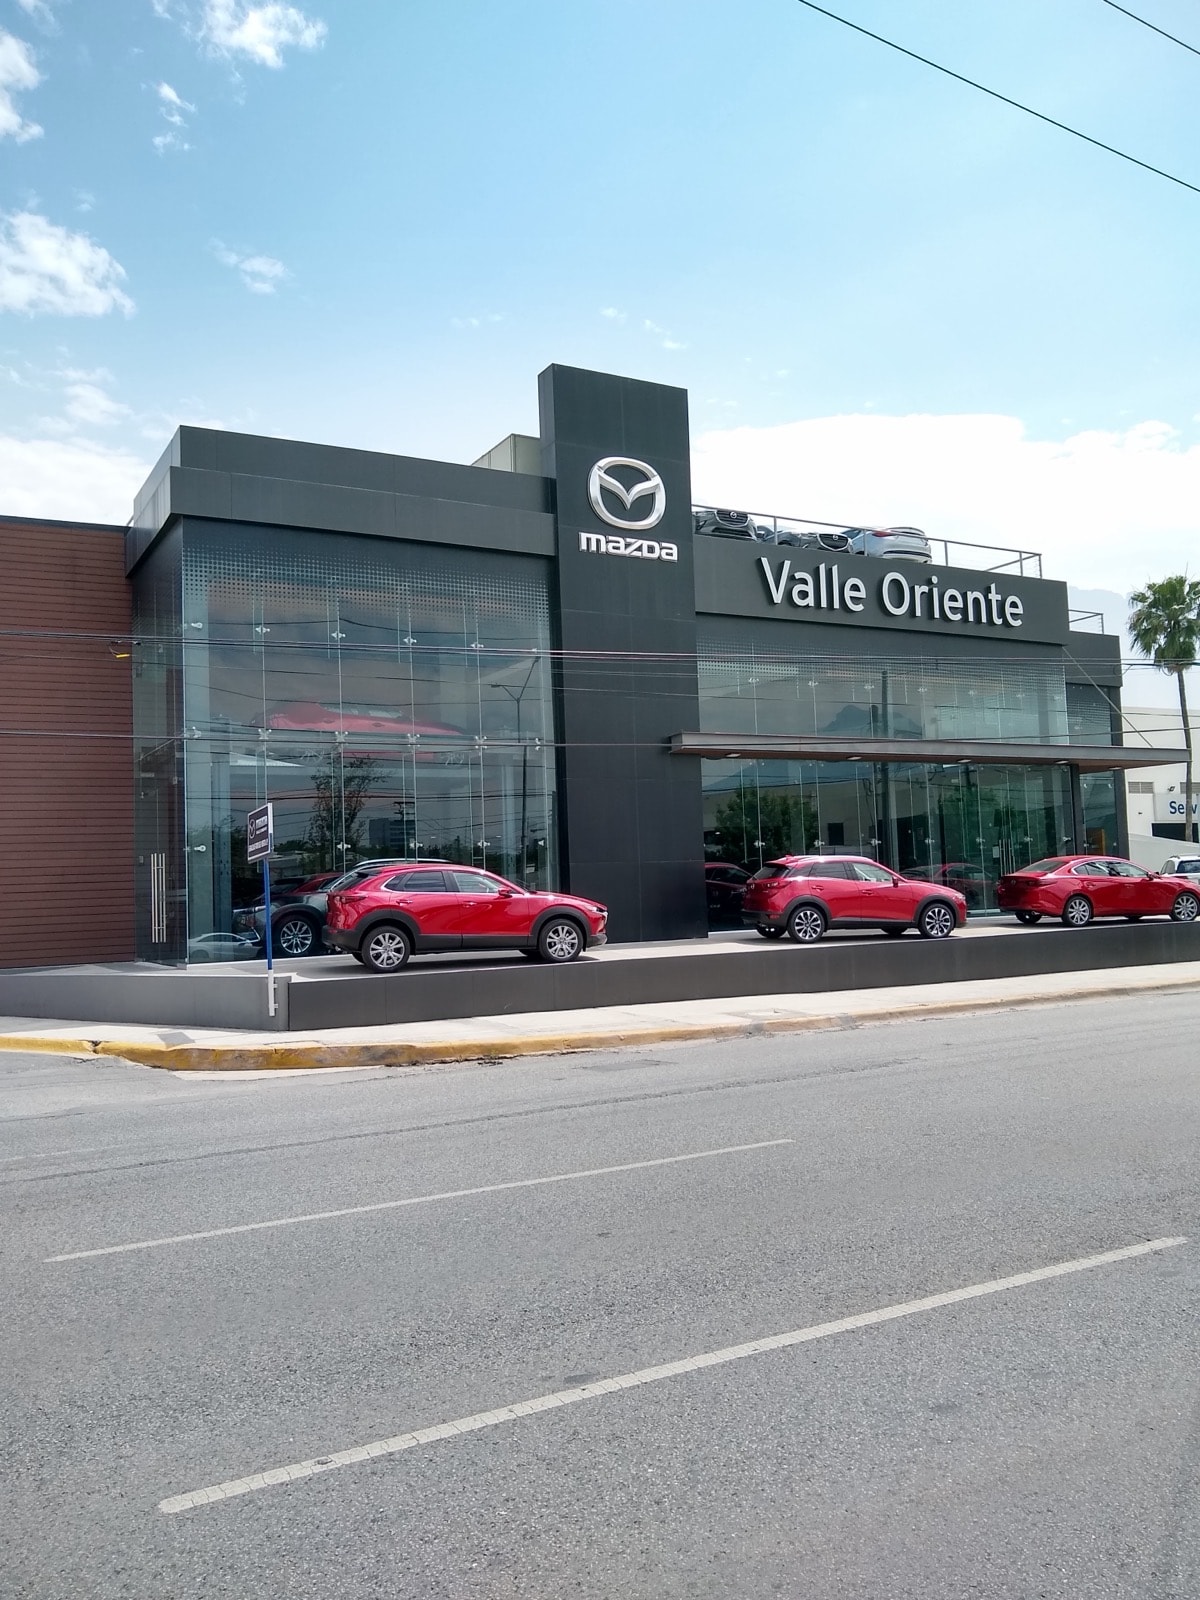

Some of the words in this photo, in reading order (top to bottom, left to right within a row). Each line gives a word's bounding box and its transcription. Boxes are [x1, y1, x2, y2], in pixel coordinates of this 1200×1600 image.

[579, 532, 678, 562] mazda
[760, 556, 867, 612] Valle
[882, 571, 1024, 627] Oriente
[1169, 800, 1197, 815] Sev
